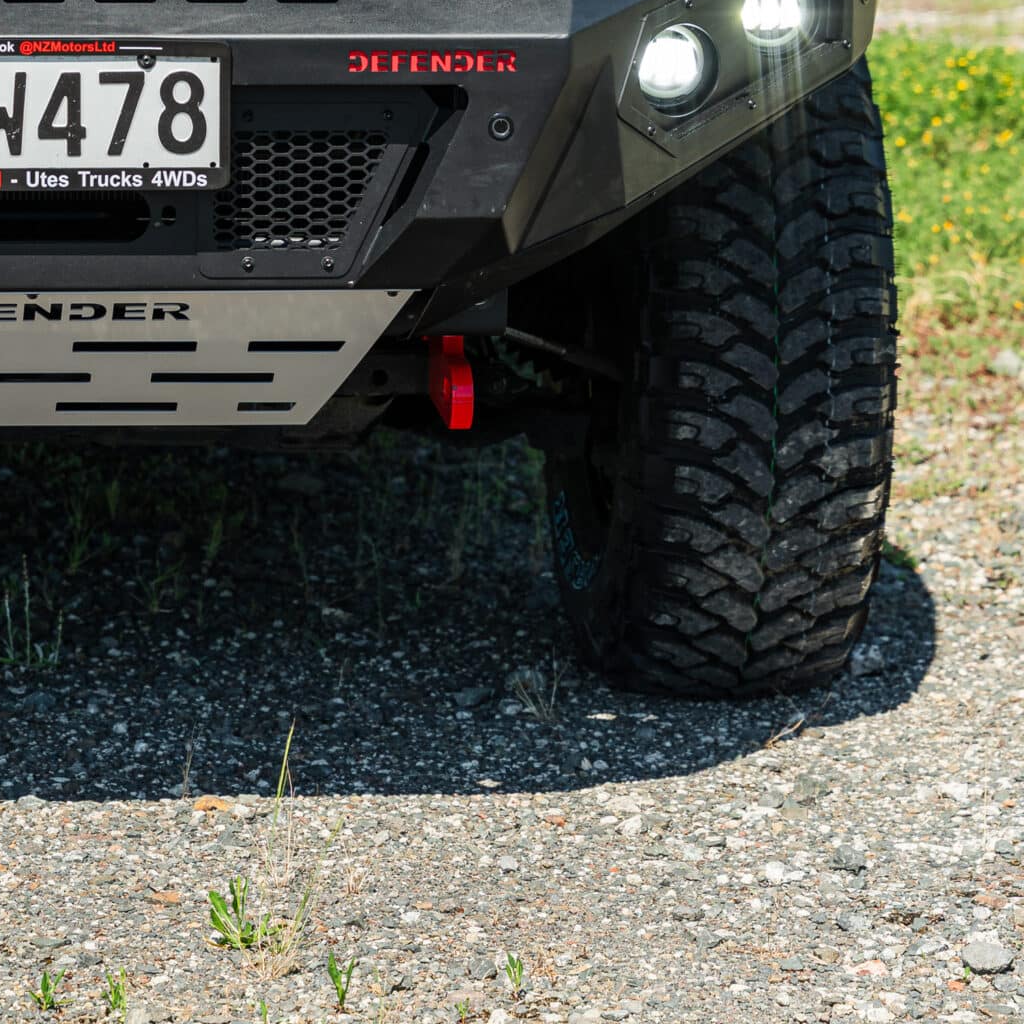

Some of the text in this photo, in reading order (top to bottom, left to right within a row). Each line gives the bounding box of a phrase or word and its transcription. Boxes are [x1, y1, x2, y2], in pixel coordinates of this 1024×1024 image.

[19, 40, 116, 55] @NZMotorsLtd
[348, 50, 517, 72] DEFENDER
[26, 171, 69, 188] Utes
[78, 171, 143, 188] Trucks
[151, 171, 208, 188] 4WDs
